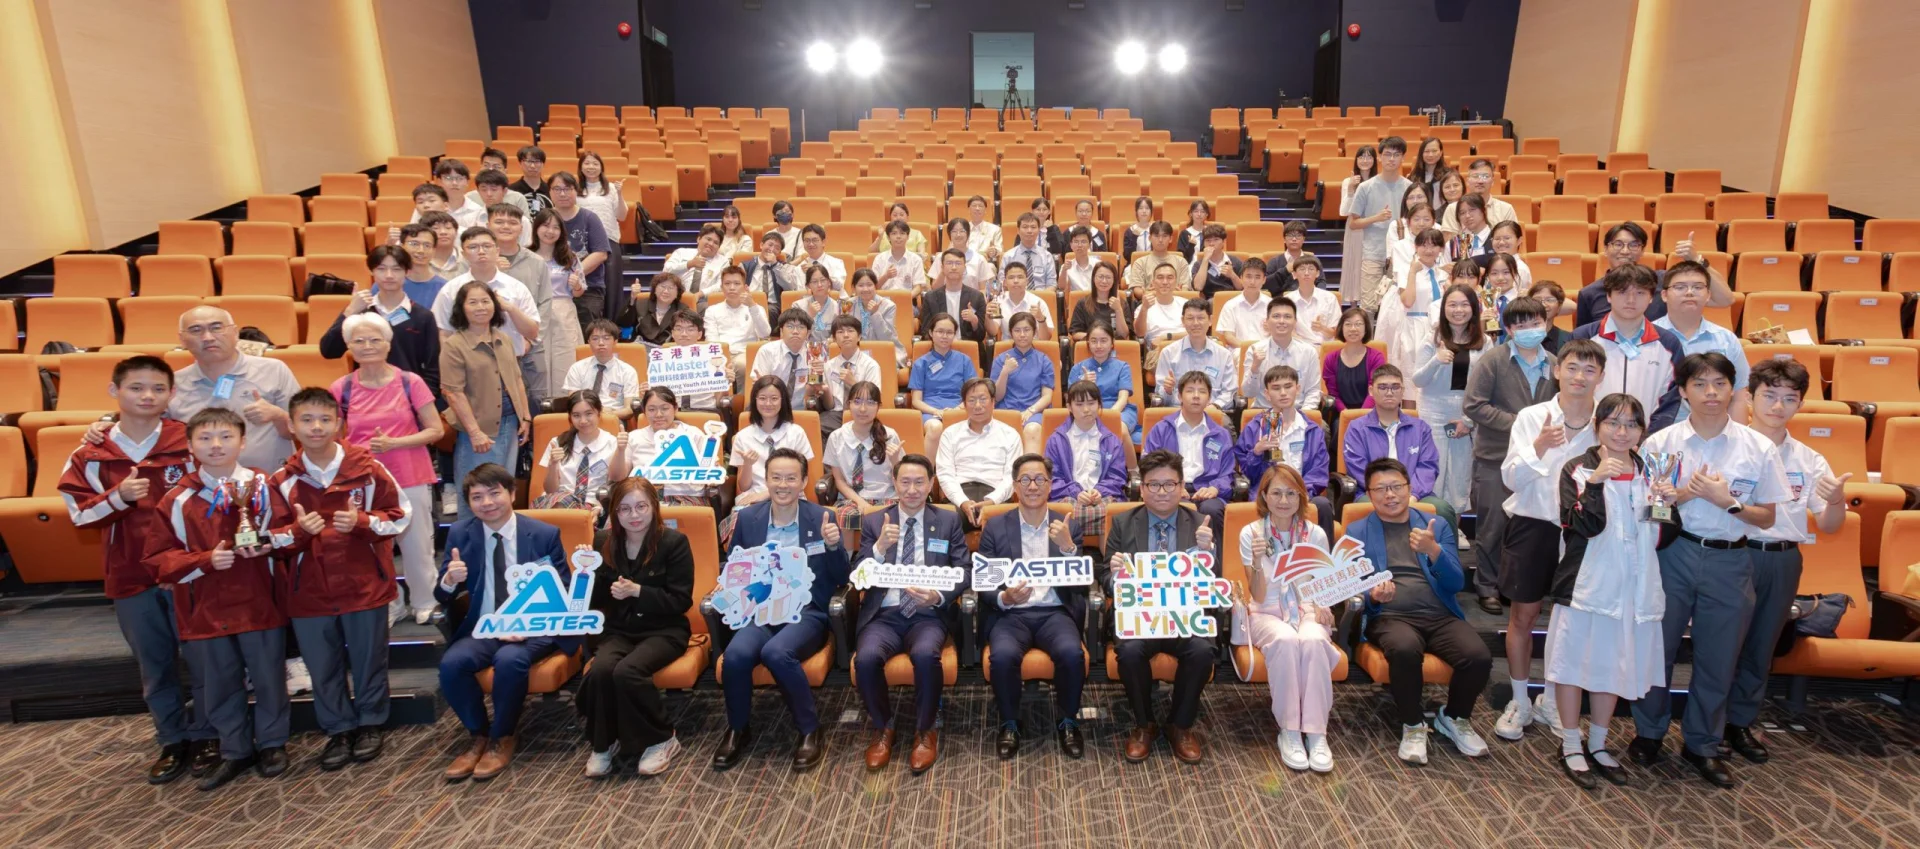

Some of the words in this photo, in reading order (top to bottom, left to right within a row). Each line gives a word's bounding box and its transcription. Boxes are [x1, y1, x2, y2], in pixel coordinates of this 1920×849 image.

[652, 344, 720, 360] 全港青年
[649, 363, 660, 373] AI
[666, 360, 708, 372] Master
[634, 469, 722, 480] MASTER
[1009, 559, 1090, 577] ASTRI
[1117, 553, 1143, 578] AI
[1151, 553, 1212, 578] FOR
[1117, 581, 1230, 607] BETTER
[1316, 589, 1336, 602] Bright
[1338, 581, 1359, 593] Future
[1320, 589, 1352, 606] Charitable
[1354, 573, 1391, 593] Foundation
[480, 615, 599, 633] MASTER
[1118, 610, 1214, 636] LIVING
